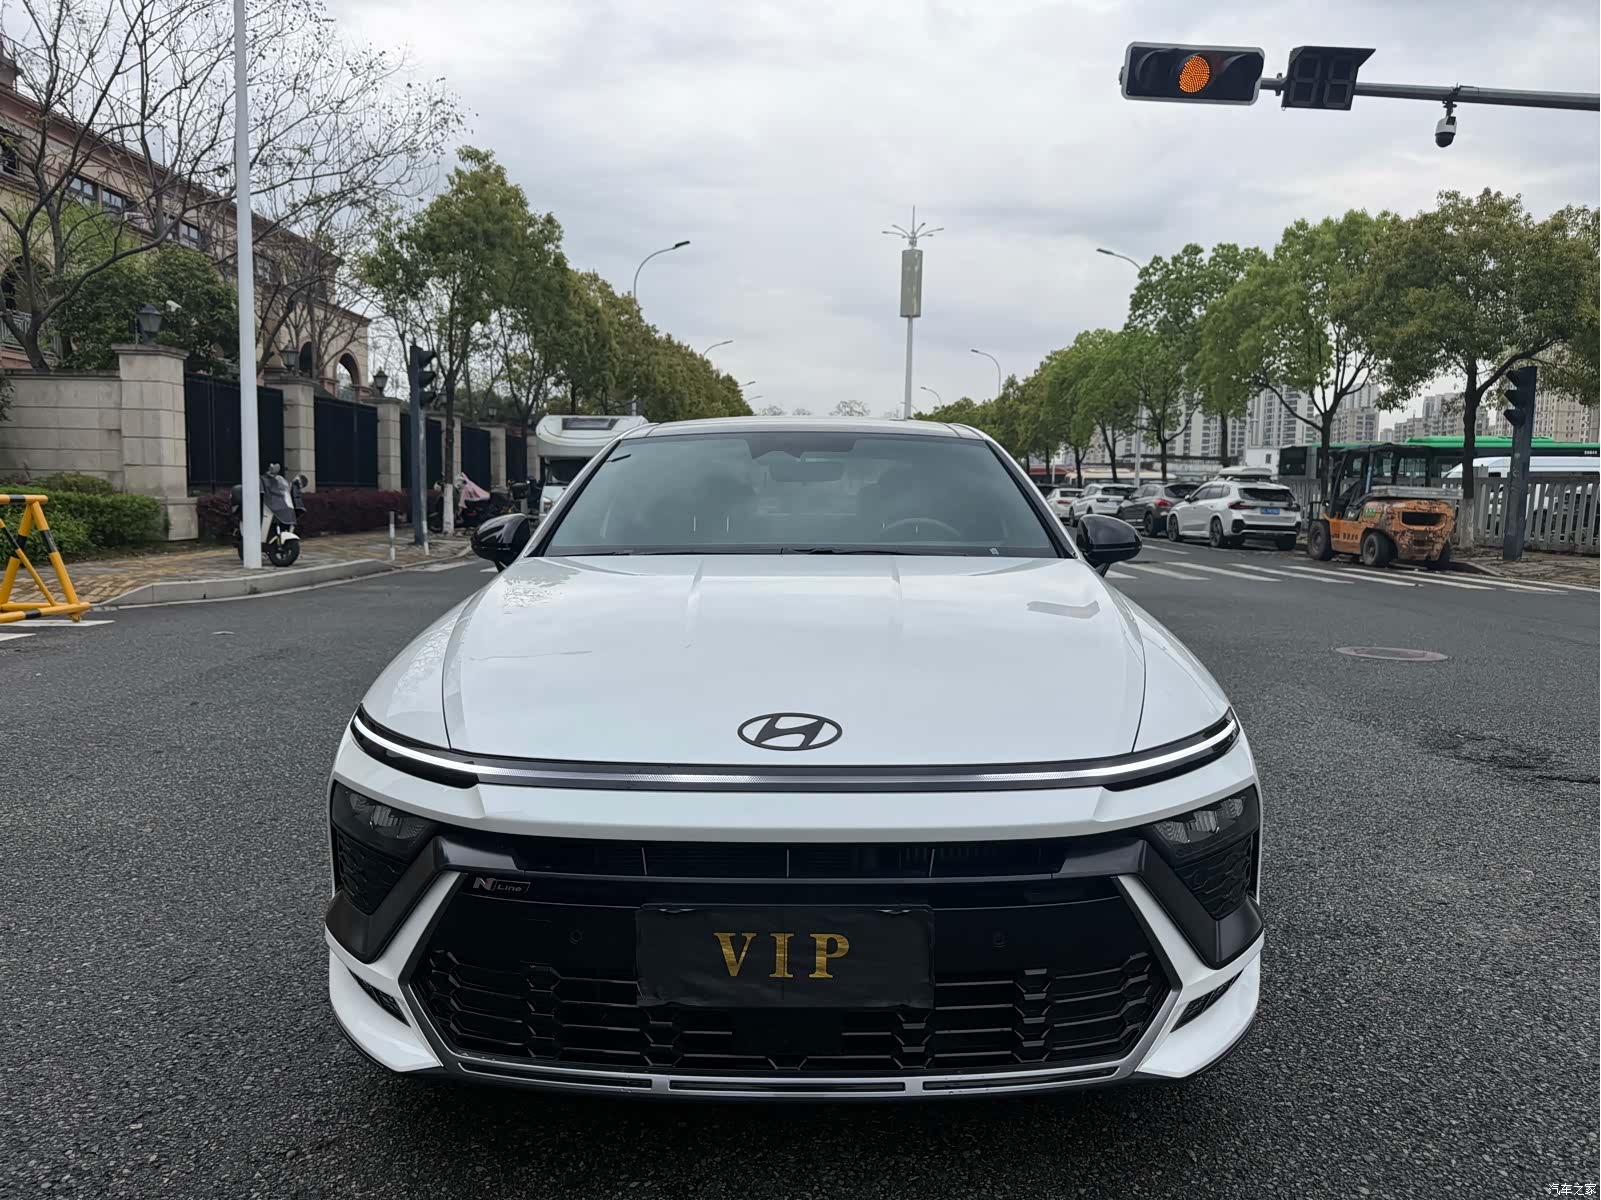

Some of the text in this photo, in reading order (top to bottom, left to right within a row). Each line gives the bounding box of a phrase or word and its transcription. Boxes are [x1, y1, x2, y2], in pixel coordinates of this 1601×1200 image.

[474, 877, 522, 892] N Line
[714, 932, 850, 978] VIP
